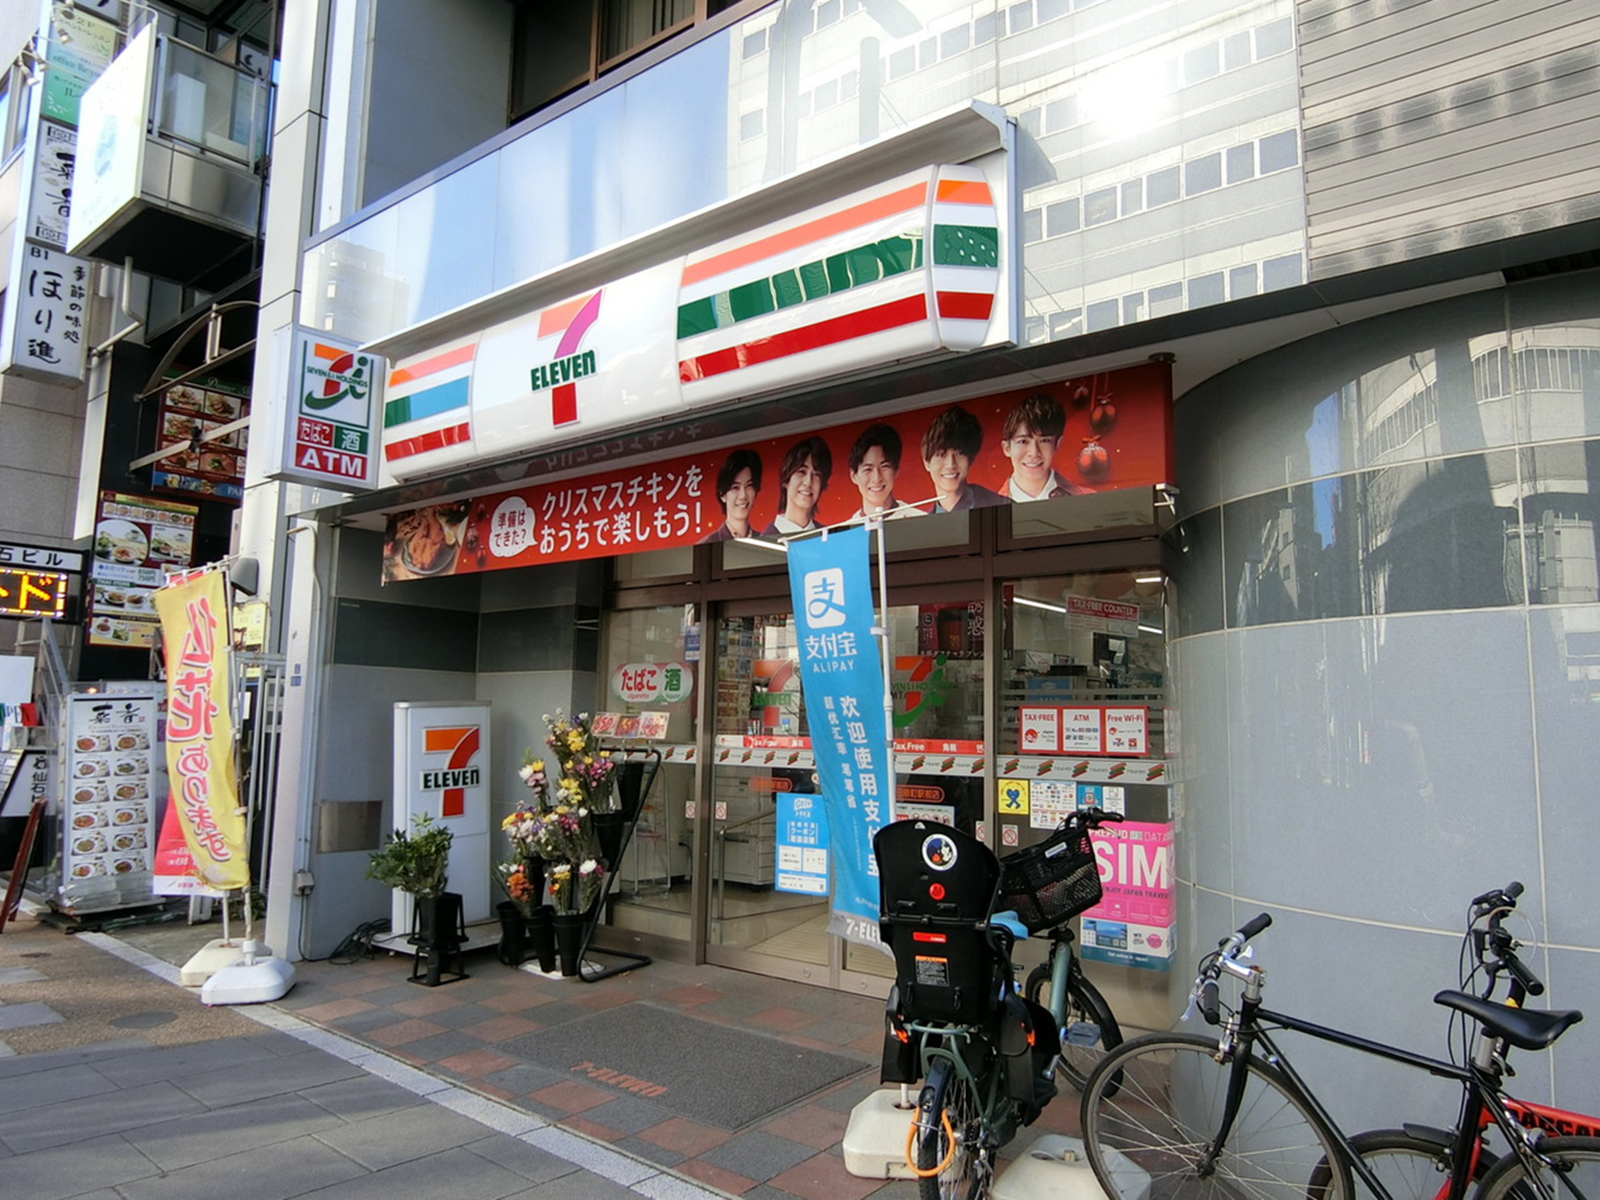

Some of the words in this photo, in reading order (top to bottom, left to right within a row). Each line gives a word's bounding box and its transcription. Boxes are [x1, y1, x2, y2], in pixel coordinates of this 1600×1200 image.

[31, 247, 49, 260] B1
[63, 265, 86, 345] 季節の味処
[29, 269, 63, 364] ほり進
[301, 420, 330, 445] たばこ
[341, 429, 361, 451] 酒
[300, 448, 363, 477] ATM
[541, 465, 703, 521] クリスマスチキンを
[496, 509, 526, 529] 準備は
[540, 502, 702, 555] おうちで楽しもう!
[493, 528, 527, 549] できた?
[1103, 603, 1134, 615] COUNTER
[804, 631, 857, 660] 支付宝
[812, 659, 854, 673] ALIPAY
[621, 668, 657, 691] たばこ
[664, 668, 681, 691] 酒
[1024, 713, 1055, 721] TAX-FREE
[1107, 714, 1123, 723] Free
[1124, 714, 1144, 722] Wi-Fi
[1144, 831, 1168, 842] DATA
[1093, 840, 1168, 890] SIM
[1123, 888, 1143, 896] JAPAN
